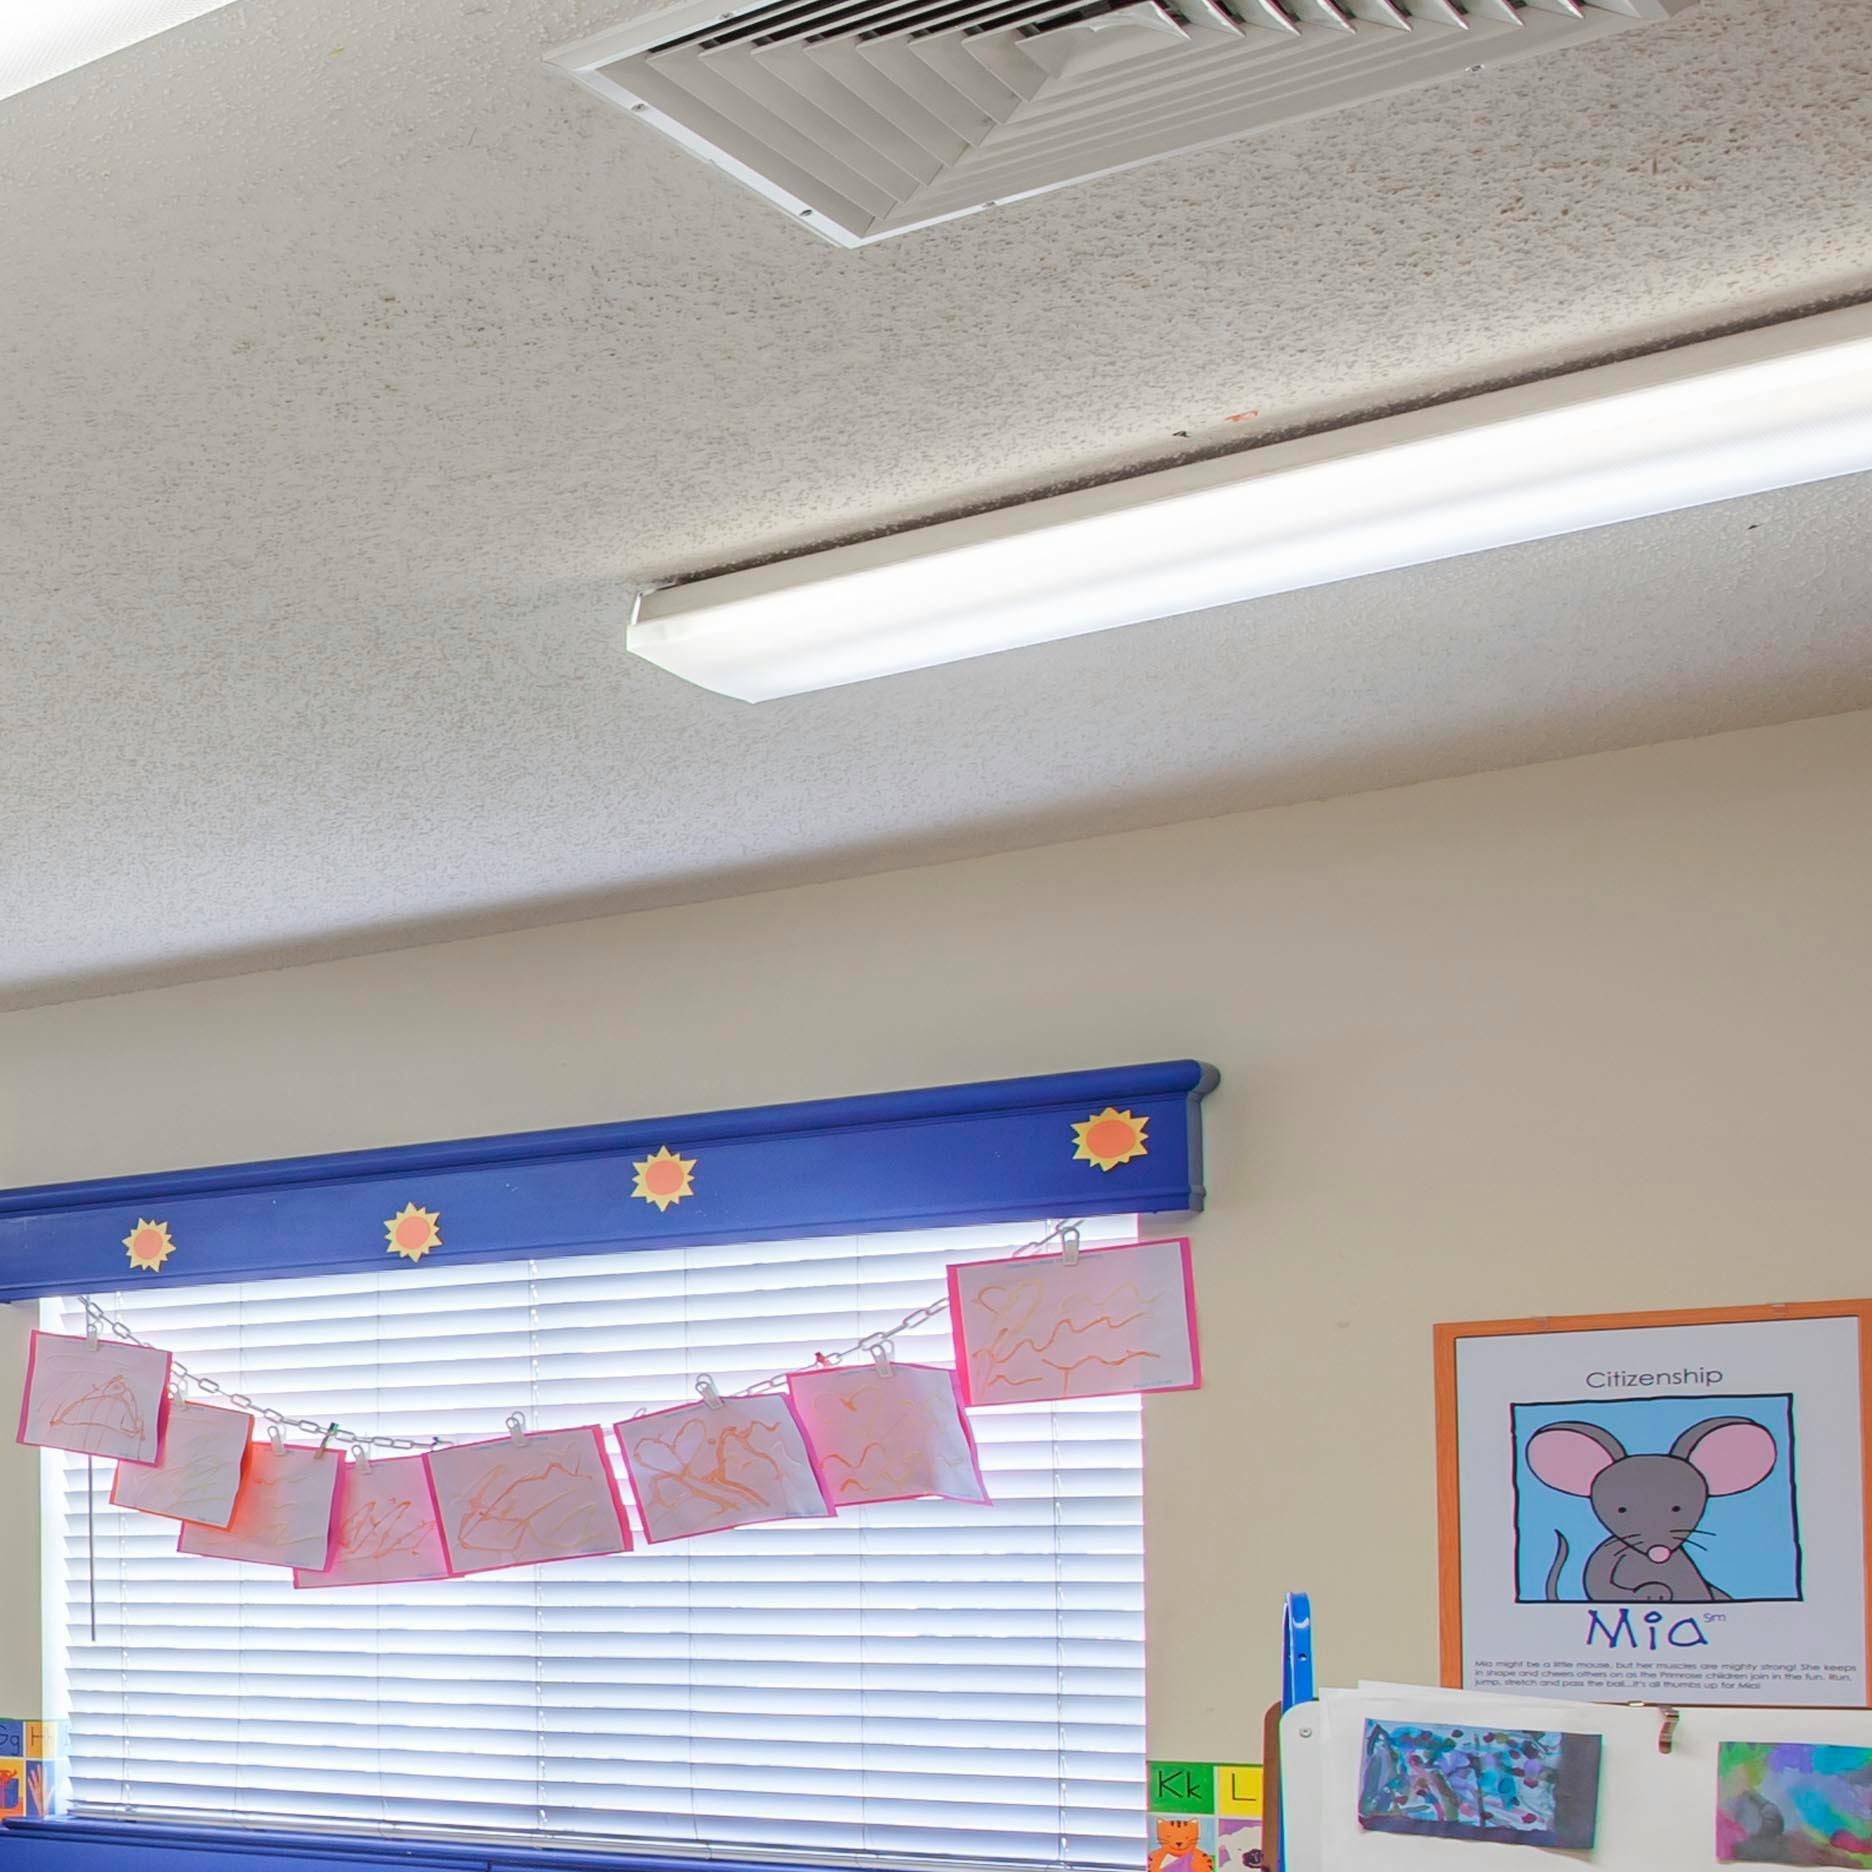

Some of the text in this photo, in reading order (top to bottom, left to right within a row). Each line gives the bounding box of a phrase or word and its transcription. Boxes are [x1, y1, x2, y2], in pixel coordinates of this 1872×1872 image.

[1586, 1366, 1723, 1389] Citizenship
[1587, 1608, 1708, 1650] Mia
[1158, 1769, 1203, 1802] Kk
